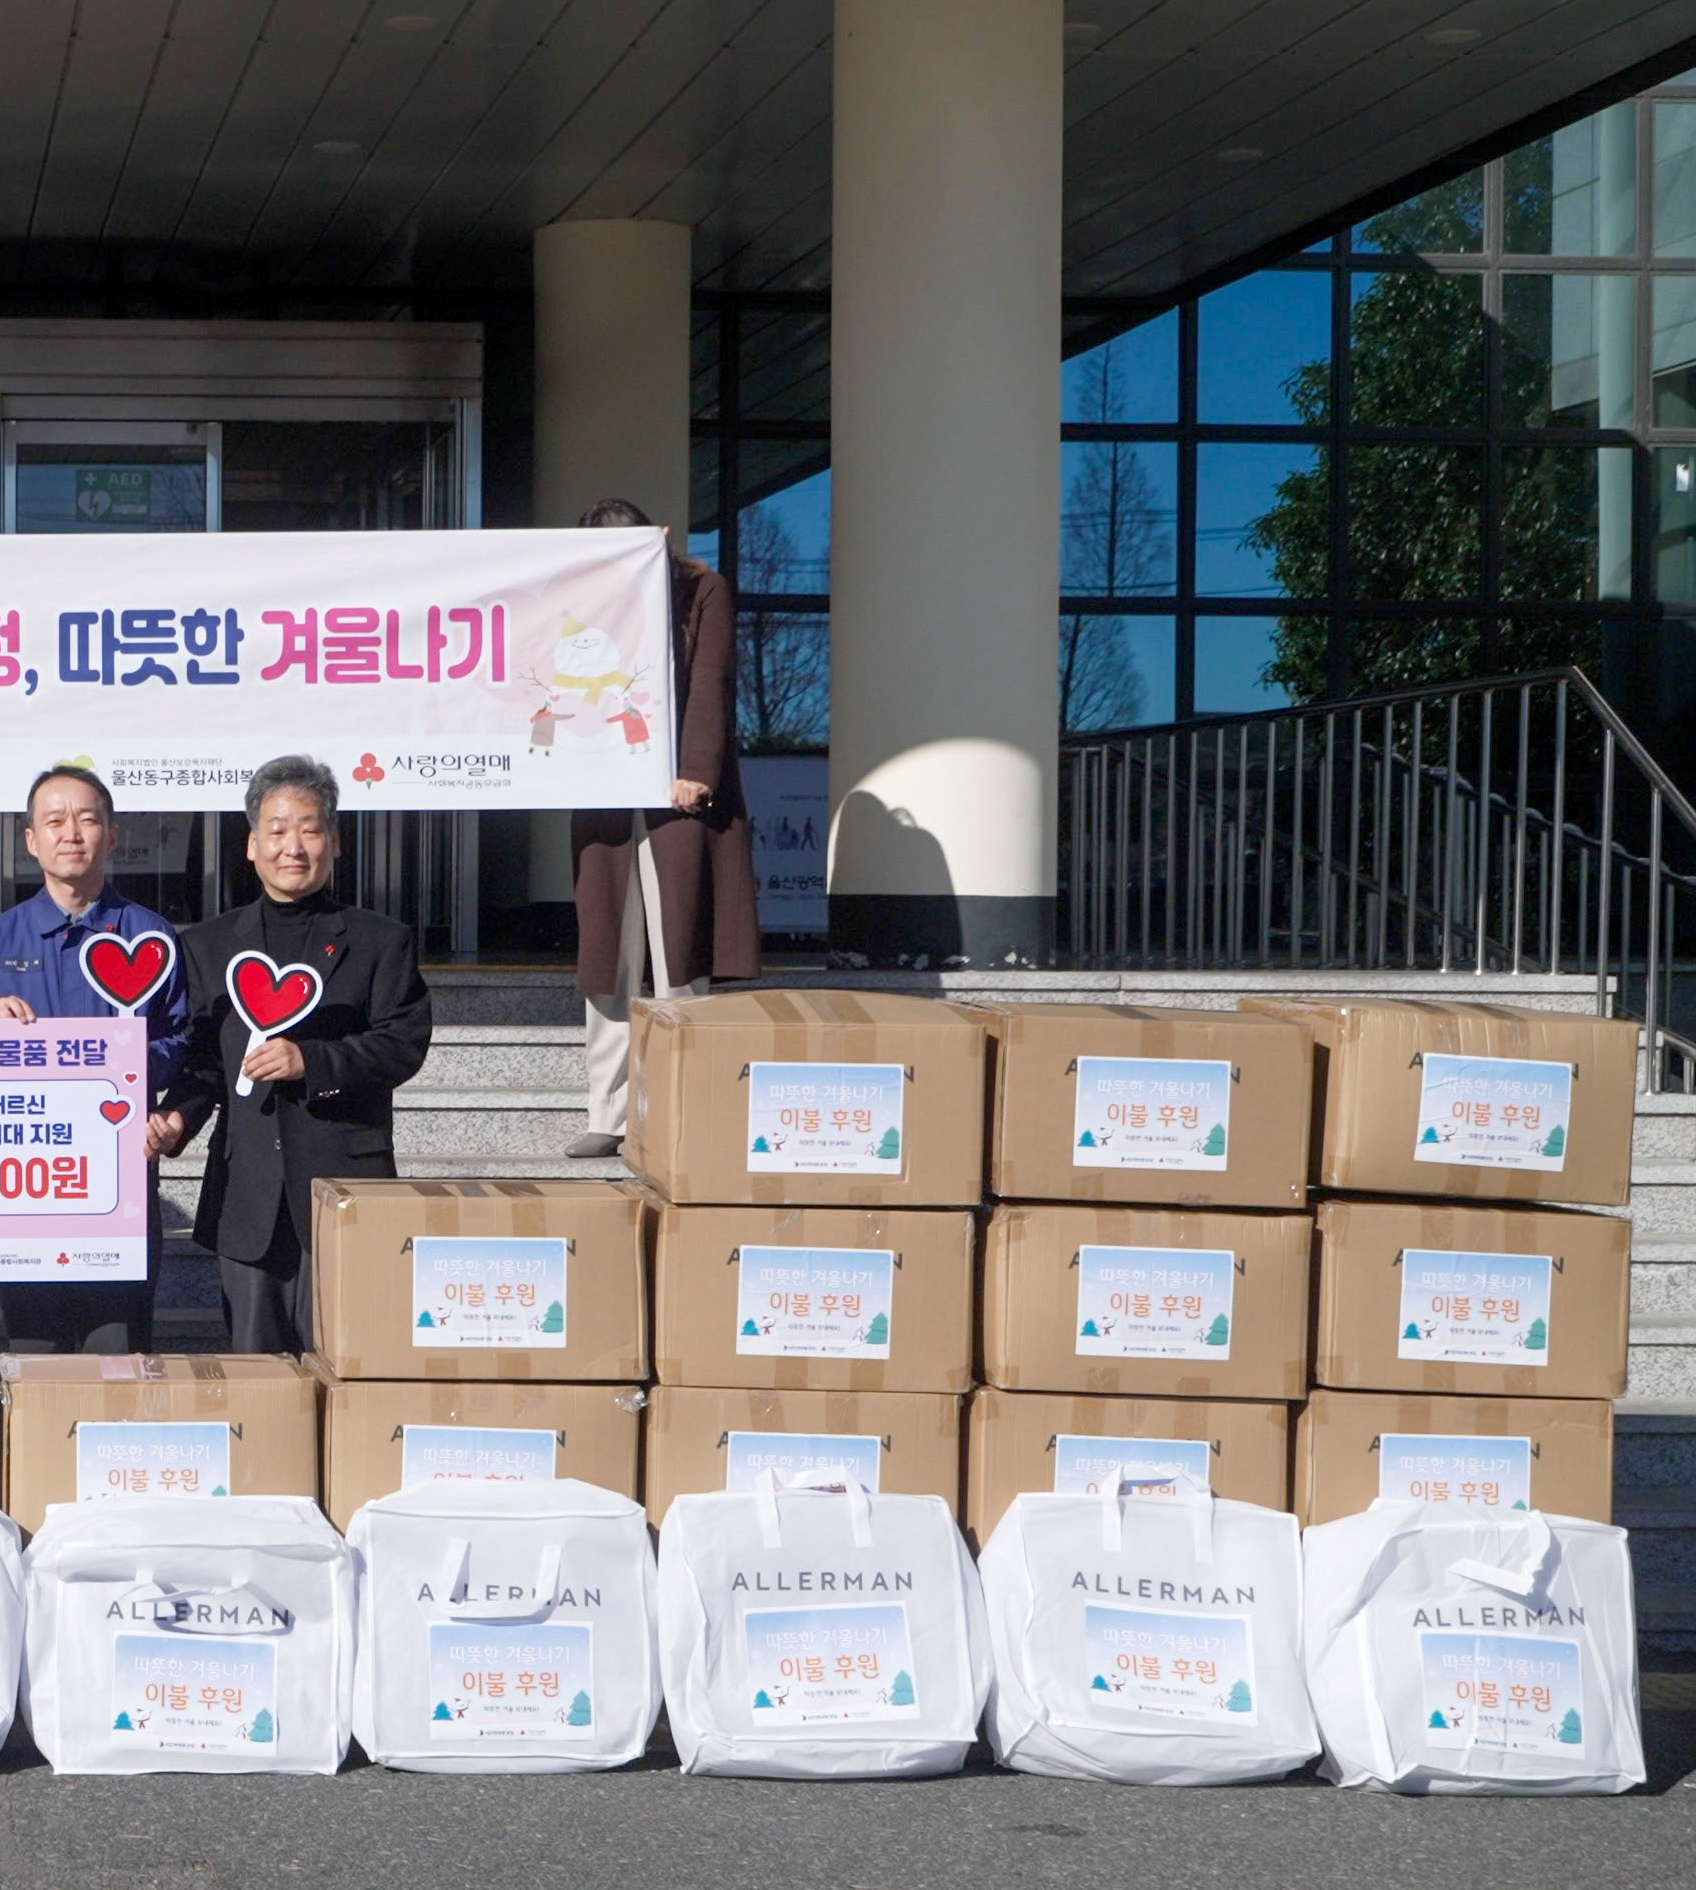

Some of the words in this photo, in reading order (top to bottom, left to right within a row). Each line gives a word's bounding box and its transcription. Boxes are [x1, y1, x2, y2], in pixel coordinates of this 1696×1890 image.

[109, 473, 143, 487] AED
[60, 608, 244, 686] 따뜻한
[261, 605, 505, 684] 겨울나기
[111, 769, 255, 786] 울산동구종합사회복
[392, 754, 510, 778] 사랑의열매
[768, 874, 828, 891] 울산광역
[56, 1039, 107, 1066] 전달
[769, 1084, 816, 1102] 따뜻한
[823, 1085, 883, 1103] 겨울나기
[1096, 1078, 1143, 1098] 따뜻한
[1150, 1080, 1210, 1100] 겨울나기
[780, 1108, 822, 1132] 이불
[830, 1108, 872, 1133] 후원
[1107, 1102, 1149, 1128] 이불
[1156, 1104, 1198, 1129] 후원
[31, 1123, 72, 1145] 지원
[433, 1259, 479, 1277] 따뜻한
[487, 1259, 546, 1277] 겨울나기
[759, 1267, 806, 1287] 따뜻한
[812, 1269, 873, 1289] 겨울나기
[1099, 1267, 1146, 1287] 따뜻한
[1153, 1270, 1214, 1290] 겨울나기
[444, 1282, 486, 1307] 이불
[494, 1283, 535, 1307] 후원
[1421, 1271, 1467, 1291] 따뜻한
[1473, 1273, 1531, 1294] 겨울나기
[769, 1291, 811, 1317] 이불
[819, 1293, 861, 1318] 후원
[1109, 1292, 1152, 1317] 이불
[1159, 1294, 1202, 1319] 후원
[1431, 1295, 1472, 1321] 이불
[1479, 1297, 1520, 1323] 후원
[96, 1444, 143, 1462] 따뜻한
[150, 1444, 210, 1462] 겨울나기
[1399, 1455, 1445, 1475] 따뜻한
[1452, 1457, 1511, 1476] 겨울나기
[108, 1468, 150, 1492] 이불
[158, 1467, 200, 1491] 후원
[1458, 1481, 1499, 1506] 후원
[732, 1571, 912, 1592] ALLERMAN
[1071, 1571, 1255, 1604] ALLERMAN
[417, 1583, 601, 1607] ALERAN
[106, 1601, 290, 1628] ALLERMAN
[1413, 1607, 1585, 1628] ALLERMAN
[764, 1630, 816, 1652] 따뜻한
[822, 1626, 888, 1649] 겨울나기
[1101, 1627, 1153, 1649] 따뜻한
[1159, 1632, 1229, 1657] 겨울나기
[450, 1647, 499, 1666] 따뜻한
[507, 1646, 570, 1665] 겨울나기
[779, 1655, 826, 1684] 이불
[832, 1652, 880, 1680] 후원
[1116, 1651, 1162, 1679] 이불
[1169, 1657, 1218, 1685] 후원
[1443, 1653, 1492, 1676] 따뜻한
[1499, 1657, 1561, 1681] 겨울나기
[133, 1656, 183, 1678] 따뜻한
[191, 1659, 255, 1682] 겨울나기
[462, 1671, 506, 1697] 이불
[515, 1671, 560, 1697] 후원
[1456, 1679, 1500, 1709] 이불
[1507, 1683, 1551, 1712] 후원
[144, 1682, 189, 1710] 이불
[198, 1685, 243, 1713] 후원
